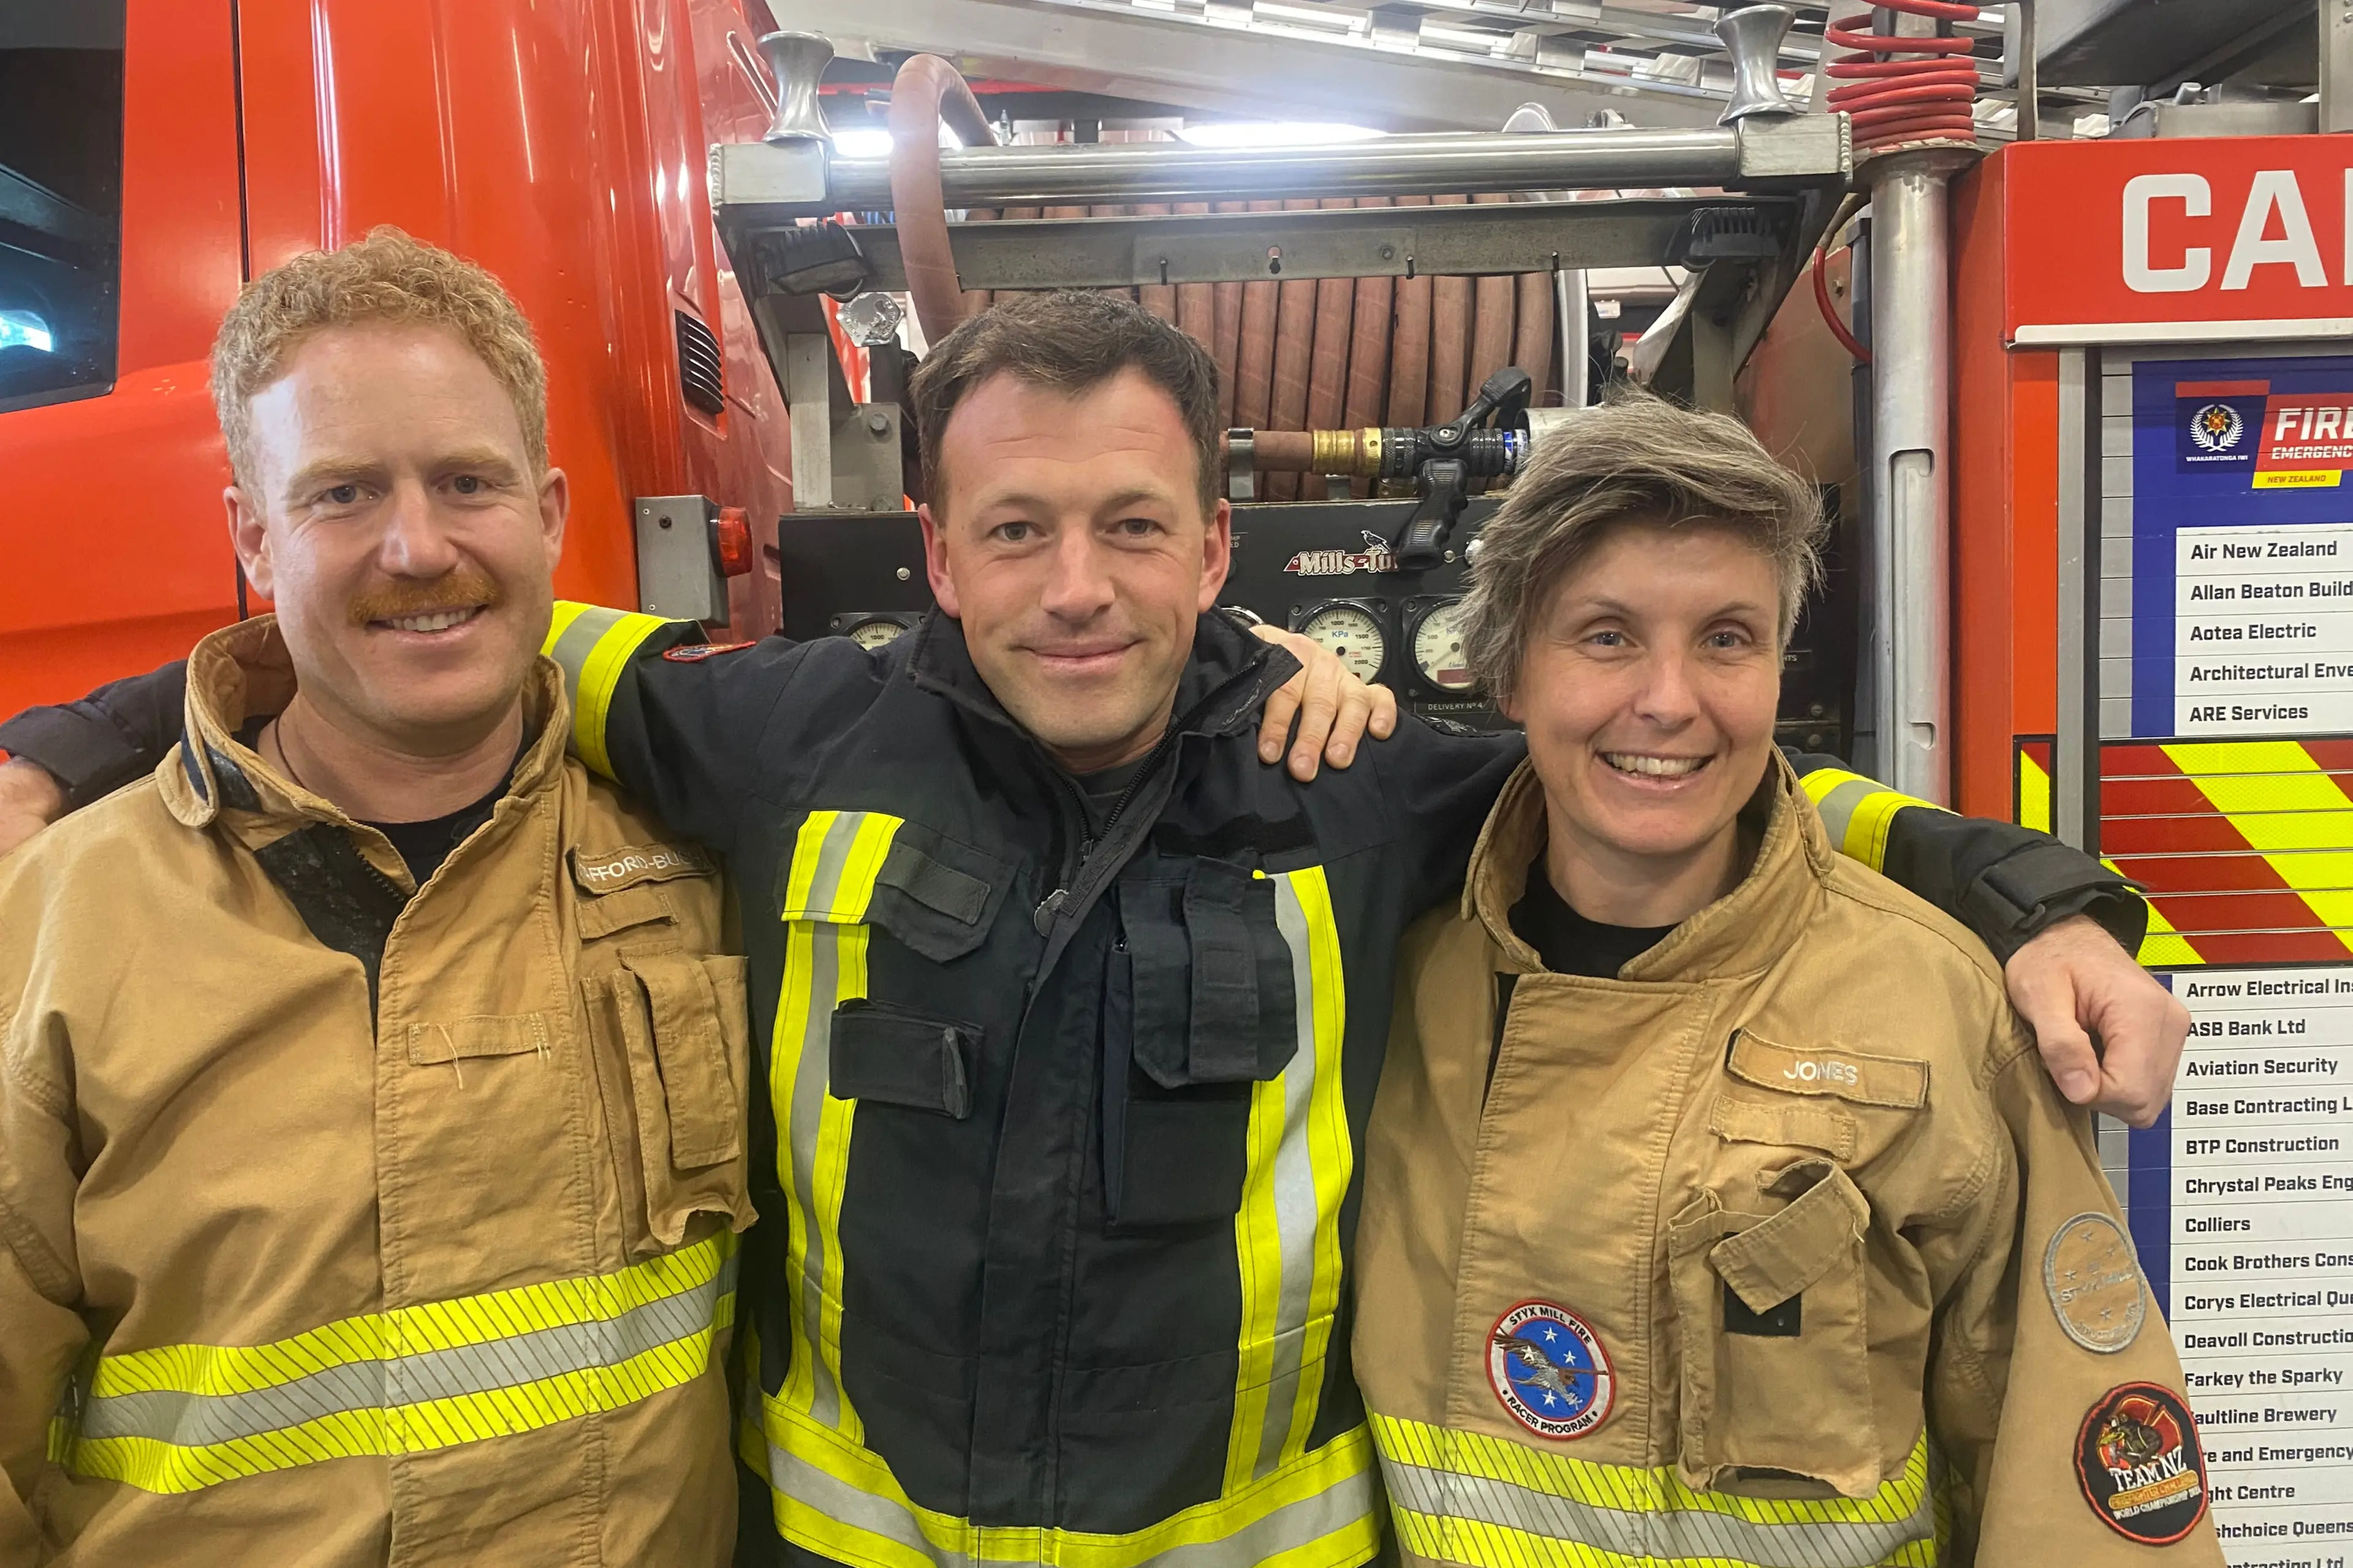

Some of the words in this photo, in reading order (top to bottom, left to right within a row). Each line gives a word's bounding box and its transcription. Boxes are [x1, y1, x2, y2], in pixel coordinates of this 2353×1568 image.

[2122, 168, 2353, 293] CA
[2191, 543, 2218, 559] Air
[2222, 543, 2262, 559] New
[2267, 540, 2337, 558] Zealand
[2191, 585, 2235, 600] Allan
[2241, 584, 2303, 599] Beaton
[2309, 581, 2353, 597] Build
[2190, 626, 2242, 641] Aotea
[2248, 623, 2316, 639] Electric
[2189, 663, 2308, 681] Architectural
[2189, 706, 2226, 722] ARE
[2232, 704, 2308, 721] Services
[2186, 983, 2241, 998] Arrow
[2247, 979, 2329, 996] Electrical
[2186, 1021, 2222, 1037] ASB
[2229, 1020, 2272, 1036] Bank
[2278, 1018, 2305, 1034] Ltd
[1783, 1061, 1859, 1086] JONES
[2186, 1060, 2259, 1077] Aviation
[2264, 1058, 2338, 1075] Security
[2186, 1101, 2229, 1116] Base
[2234, 1097, 2337, 1114] Contracting
[2186, 1140, 2221, 1154] BTP
[2226, 1137, 2339, 1153] Construction
[2186, 1176, 2259, 1195] Chrystal
[2265, 1175, 2317, 1191] Peaks
[2322, 1175, 2353, 1191] Eng
[2186, 1217, 2251, 1232] Colliers
[2185, 1256, 2228, 1271] Cook
[2234, 1254, 2309, 1270] Brothers
[2185, 1296, 2235, 1312] Corys
[2240, 1290, 2321, 1308] Electrical
[1510, 1306, 1537, 1325] STYX
[1539, 1306, 1564, 1322] MILL
[1569, 1320, 1592, 1345] FIRE
[2184, 1332, 2247, 1349] Deavoll
[2253, 1328, 2353, 1346] Constructio
[2185, 1371, 2244, 1388] Farkey
[2249, 1370, 2276, 1385] the
[2282, 1368, 2343, 1386] Sparky
[1507, 1396, 1539, 1428] RACER
[1540, 1415, 1593, 1434] PROGRAM
[2191, 1409, 2259, 1425] aultline
[2264, 1408, 2337, 1423] Brewery
[2222, 1447, 2253, 1462] and
[2259, 1446, 2353, 1461] Emergency
[2109, 1463, 2162, 1492] TEAM
[2151, 1445, 2188, 1479] NZ
[2237, 1485, 2295, 1500] Centre
[2113, 1505, 2140, 1520] WORLD
